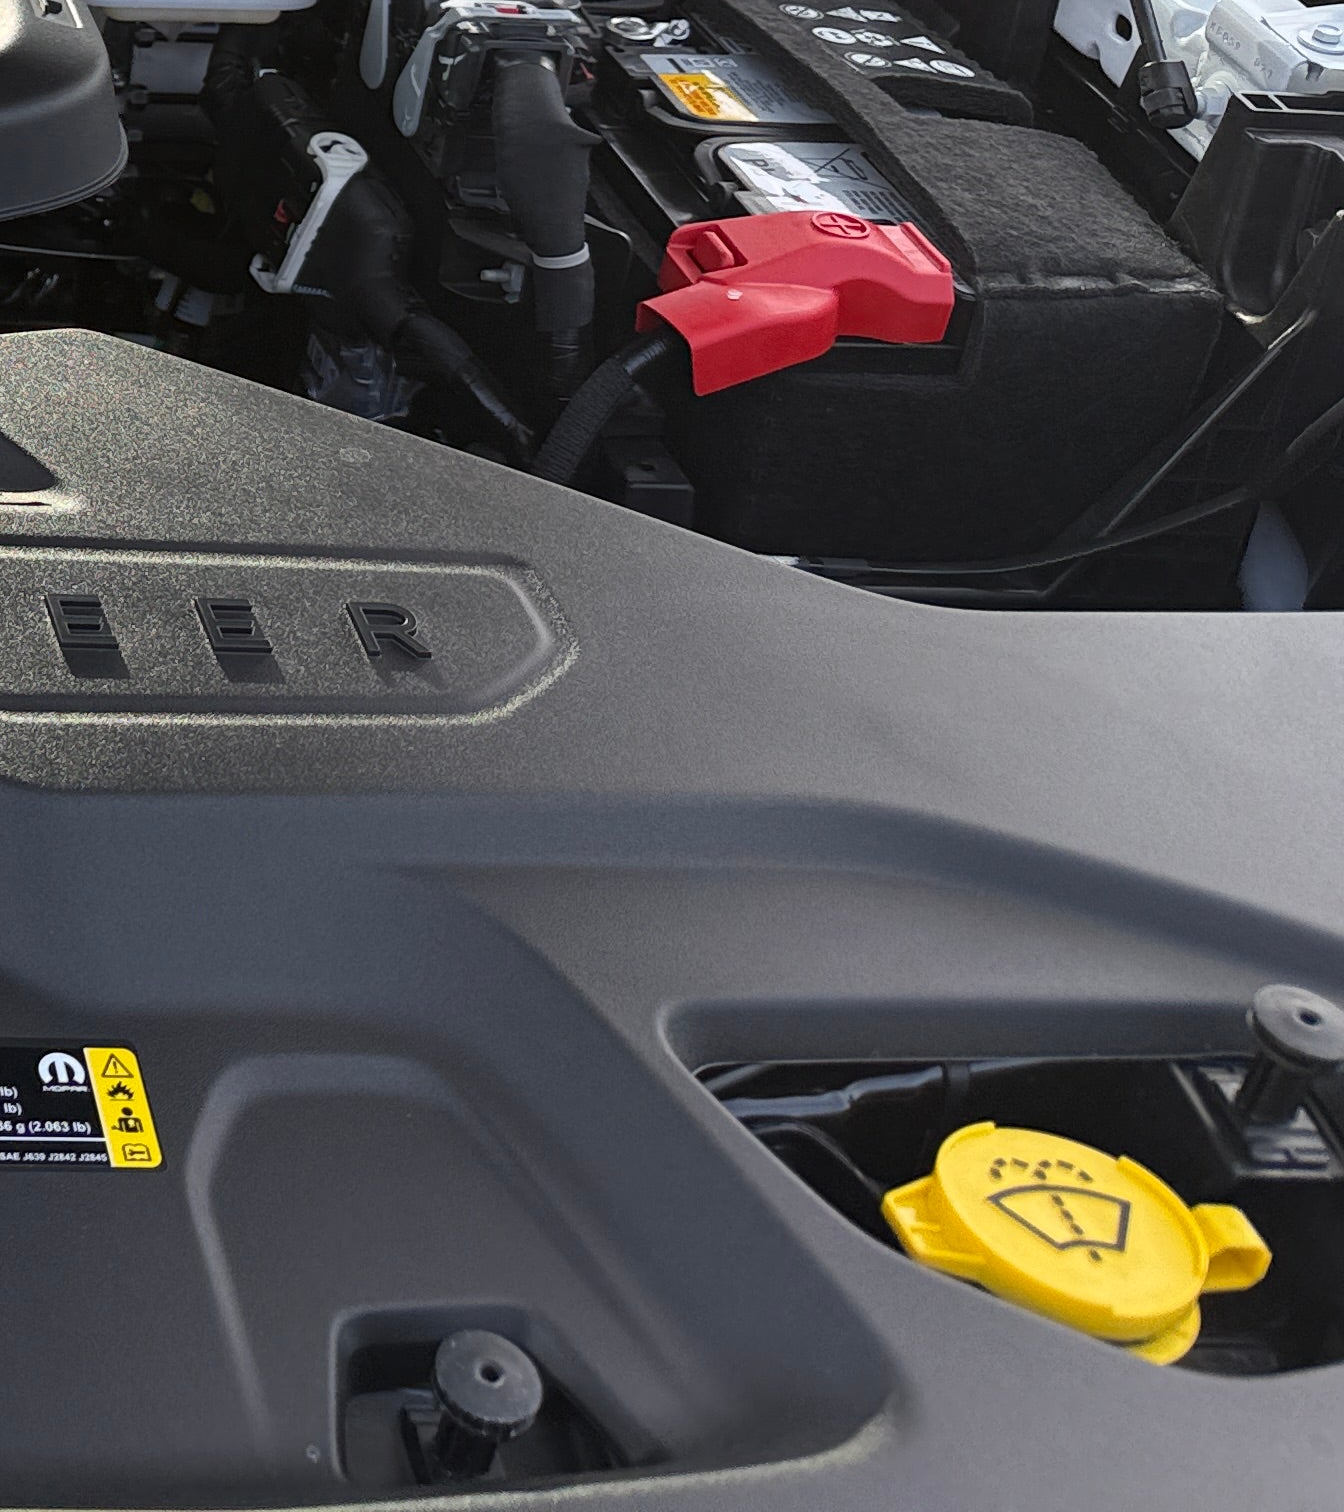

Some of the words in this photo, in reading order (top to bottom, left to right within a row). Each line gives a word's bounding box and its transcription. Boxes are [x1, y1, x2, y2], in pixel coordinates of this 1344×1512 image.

[0, 1086, 18, 1099] lb)
[4, 1103, 22, 1116] lb)
[16, 1123, 25, 1134] g
[28, 1120, 70, 1134] (2.063
[73, 1121, 91, 1134] lb)
[0, 1152, 20, 1161] SAE
